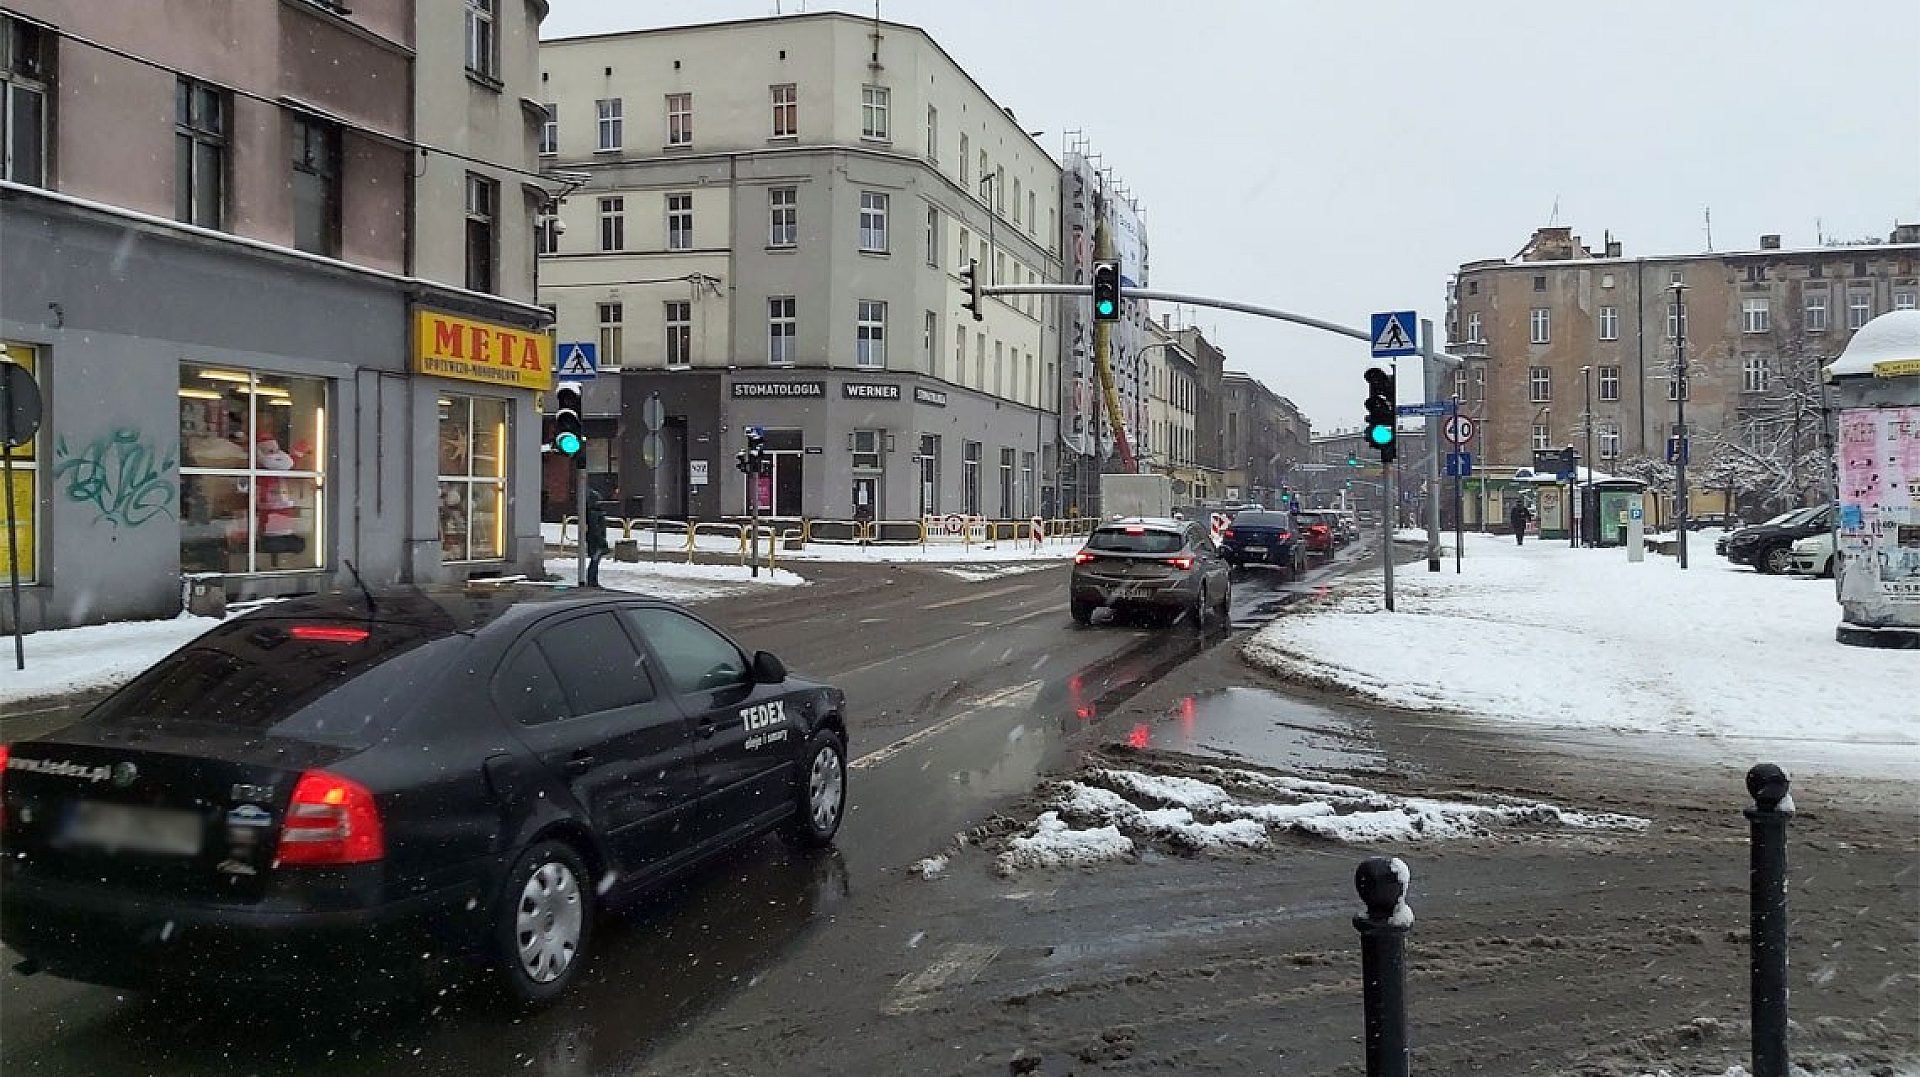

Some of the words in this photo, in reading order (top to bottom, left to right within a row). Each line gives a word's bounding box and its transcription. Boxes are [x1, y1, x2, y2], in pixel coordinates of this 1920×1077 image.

[433, 320, 541, 371] META
[735, 384, 821, 396] STOMATOLOGIA
[846, 384, 899, 398] WERNER
[740, 700, 786, 731] TEDEX
